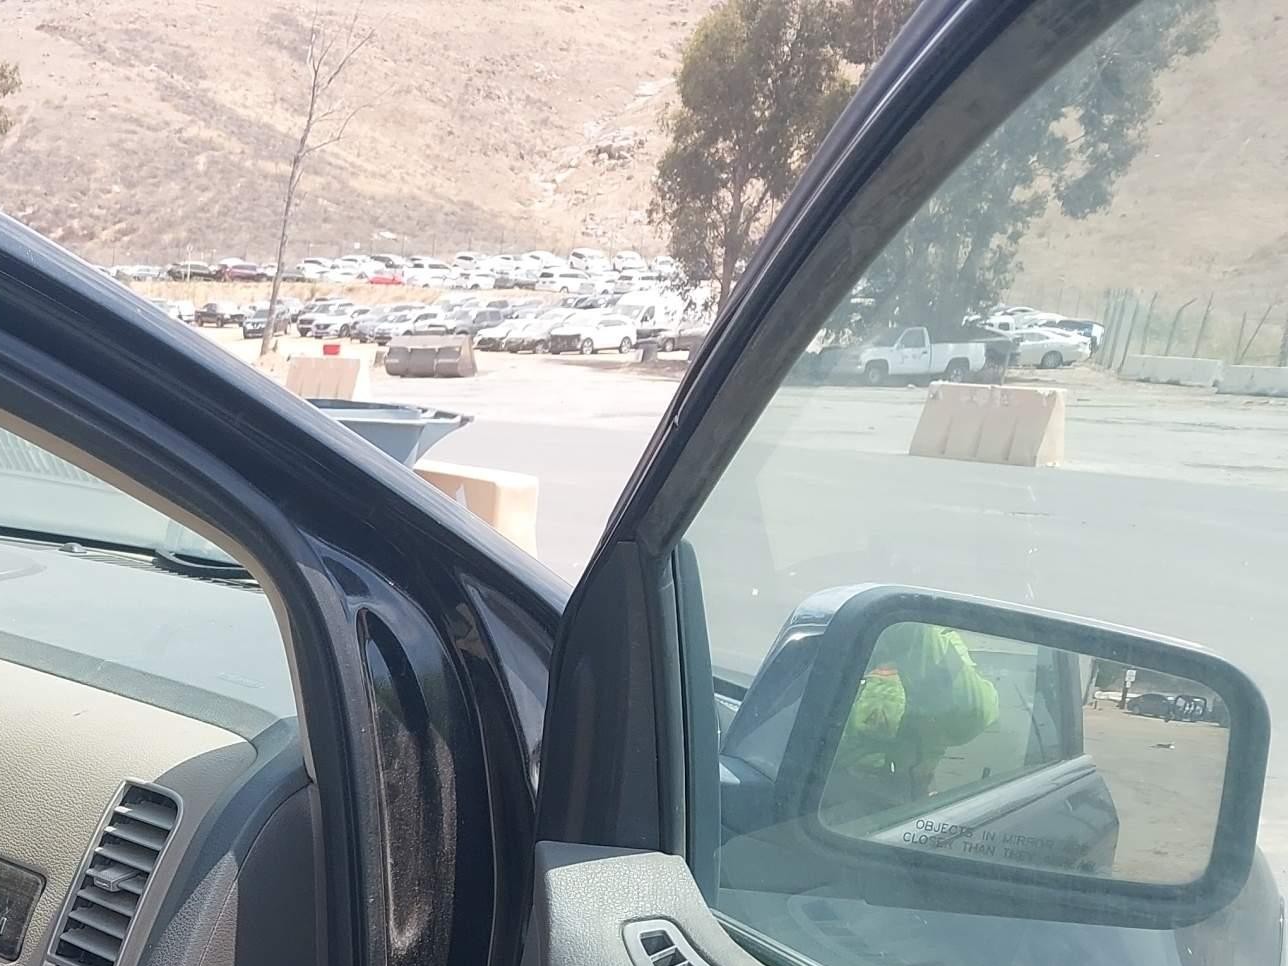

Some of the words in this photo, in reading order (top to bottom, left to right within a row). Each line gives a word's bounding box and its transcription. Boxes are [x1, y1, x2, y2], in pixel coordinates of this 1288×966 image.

[916, 819, 973, 838] OBJECTS
[982, 830, 996, 841] IN
[902, 831, 953, 849] CLOSER
[963, 841, 995, 856] THAN
